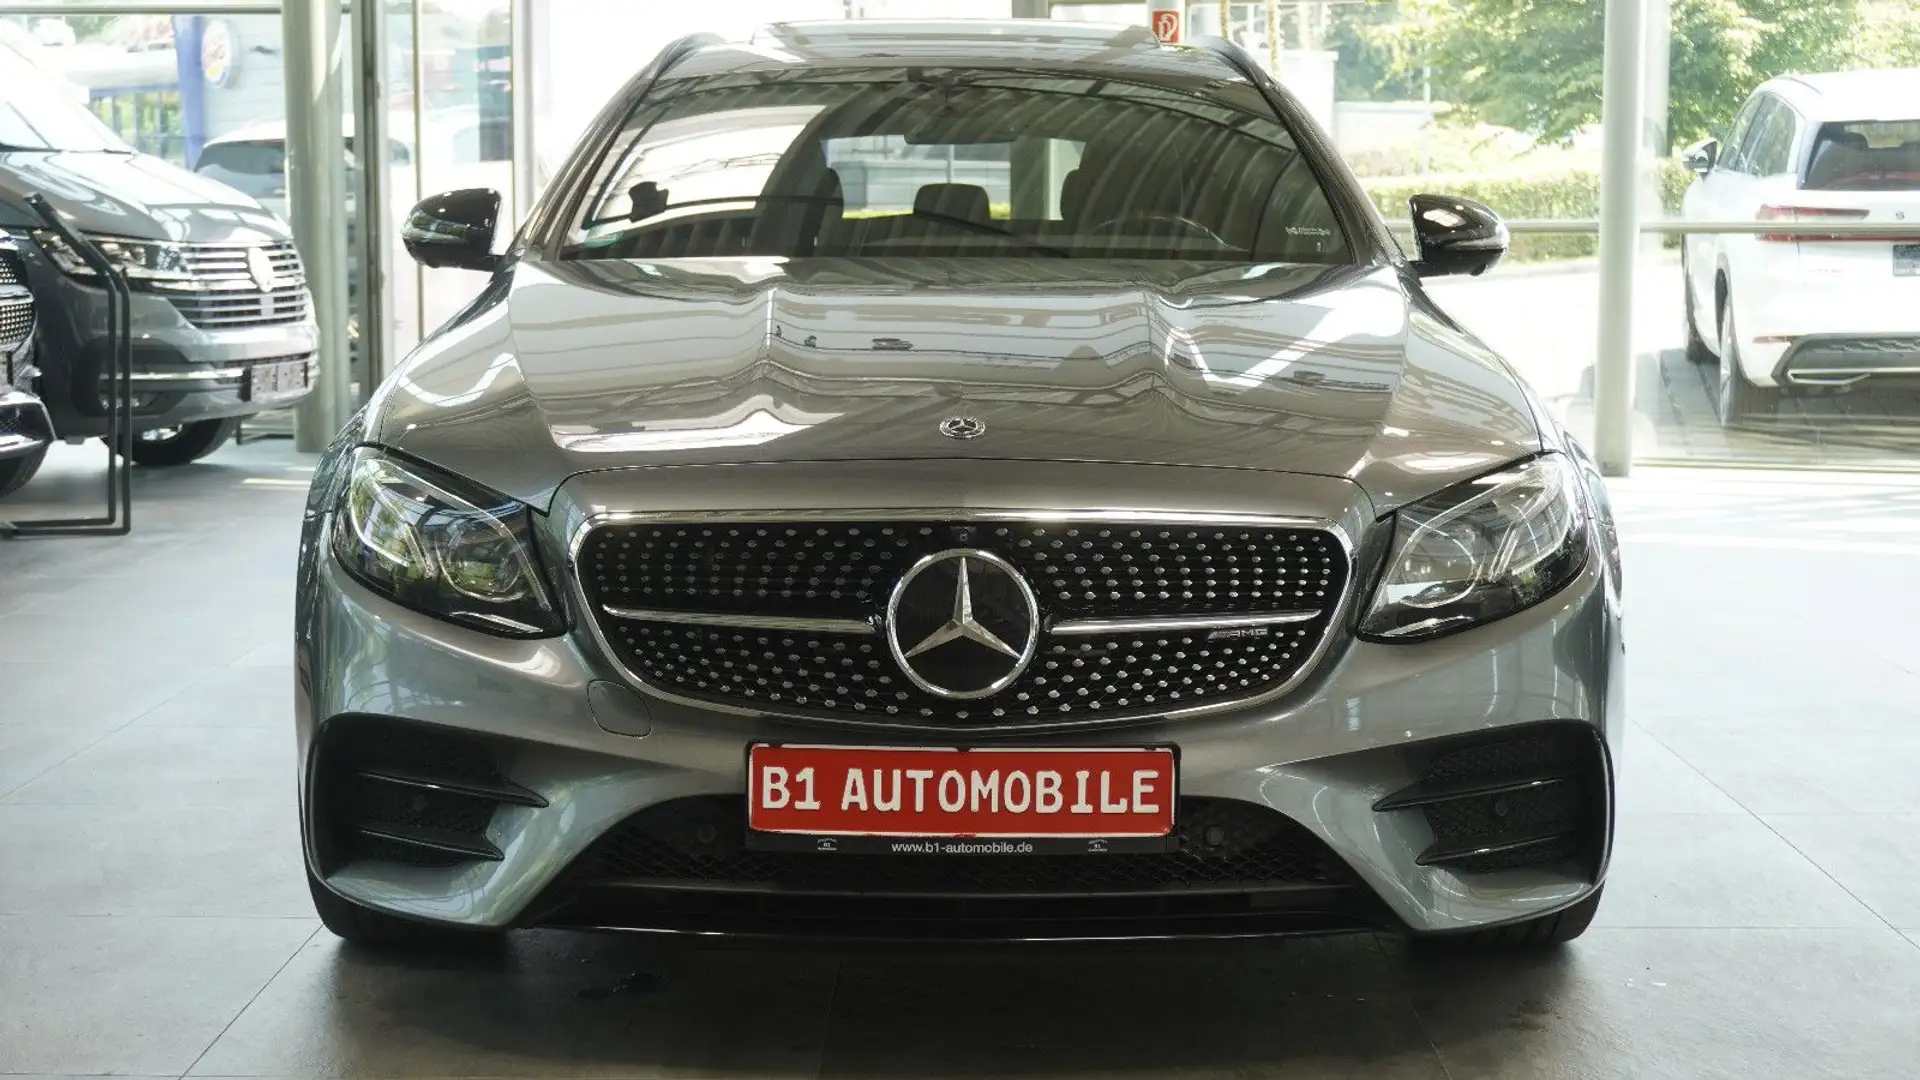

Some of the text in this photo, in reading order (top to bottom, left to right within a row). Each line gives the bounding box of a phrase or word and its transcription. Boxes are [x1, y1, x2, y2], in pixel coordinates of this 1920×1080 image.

[762, 766, 1160, 814] B1 AUTOMOBILE
[891, 841, 1033, 854] www.b1-automobile.de
